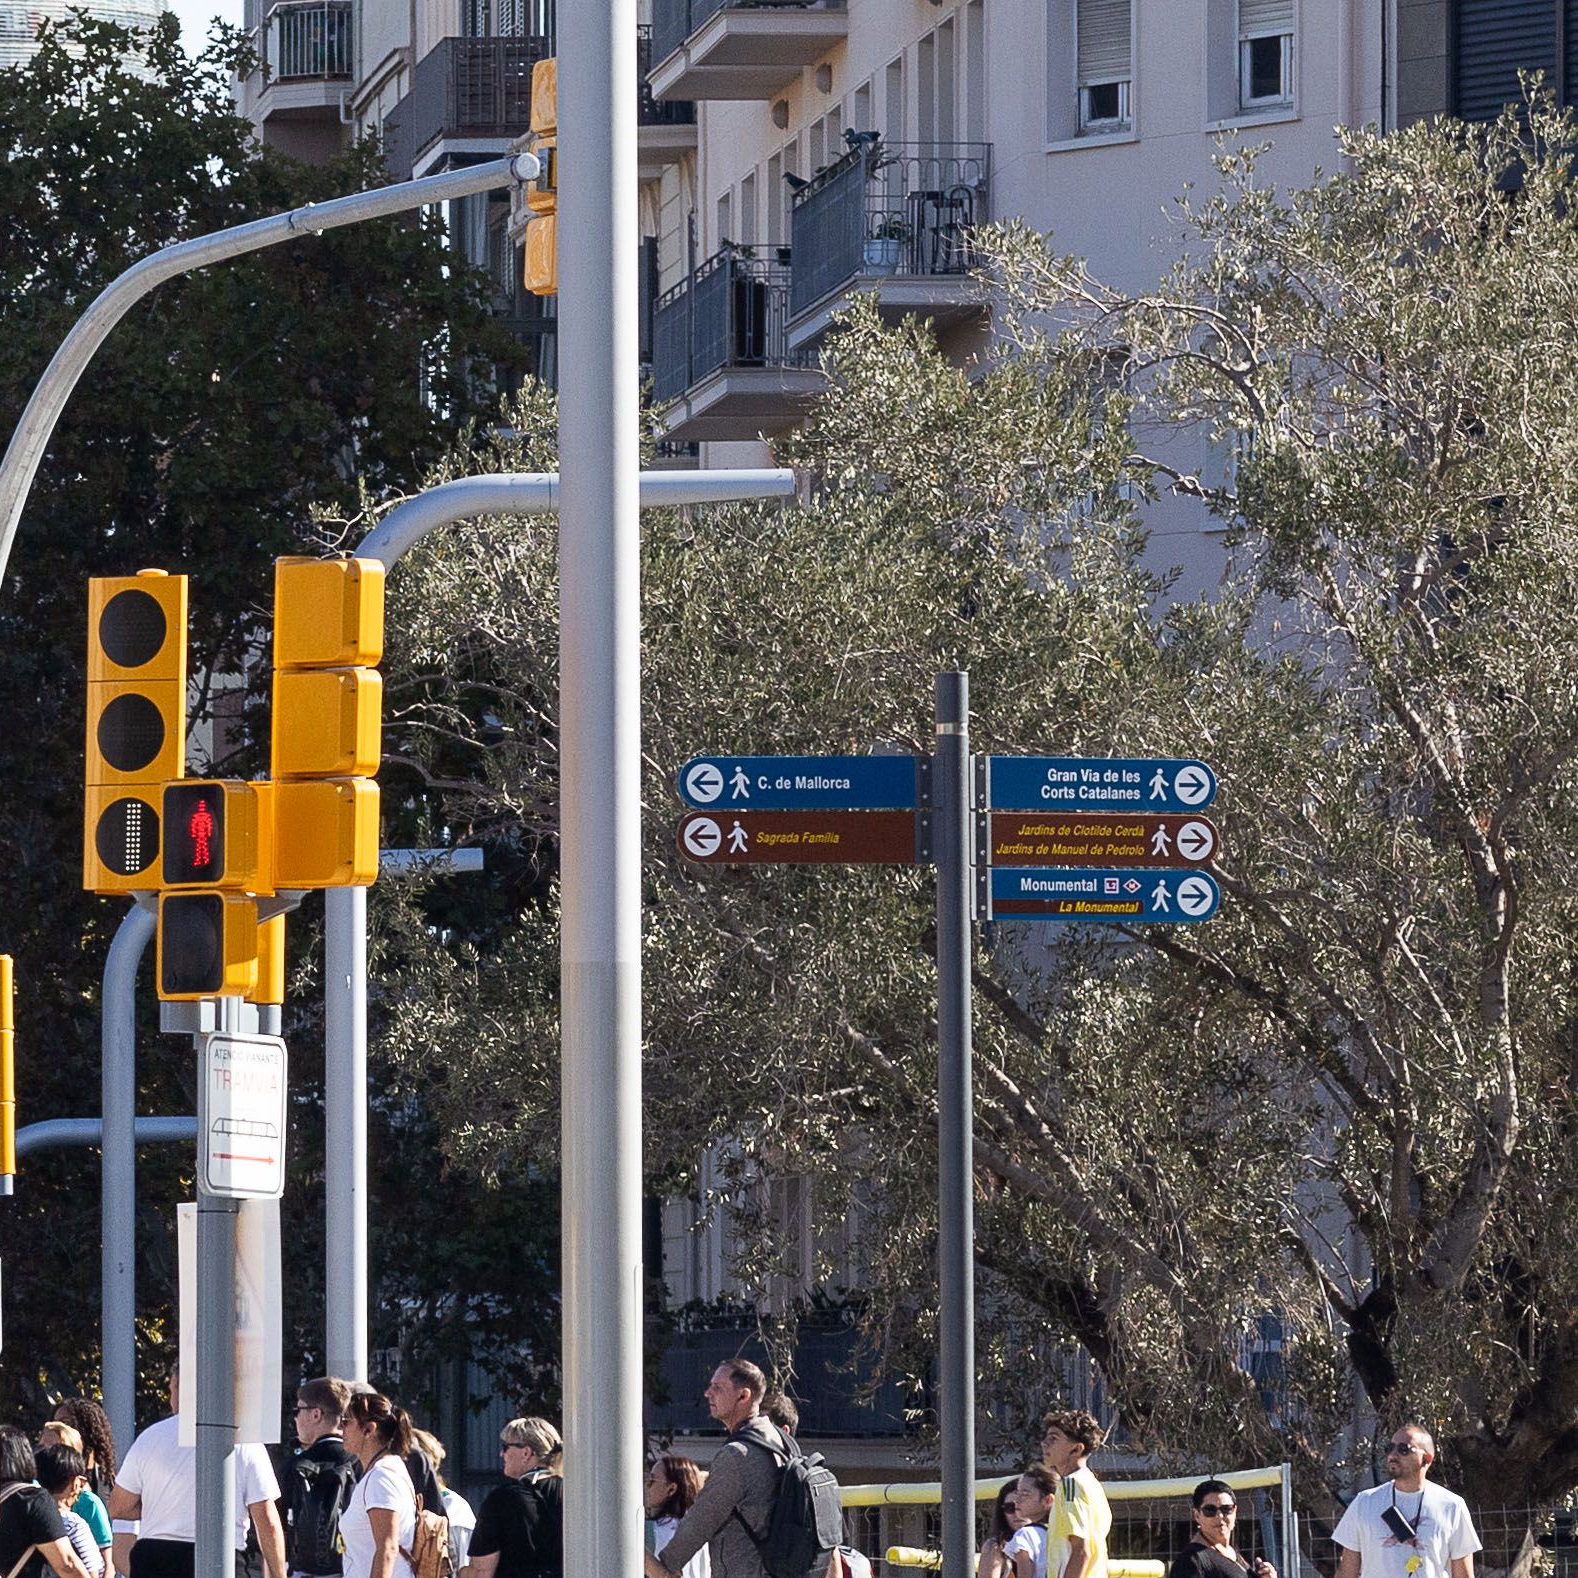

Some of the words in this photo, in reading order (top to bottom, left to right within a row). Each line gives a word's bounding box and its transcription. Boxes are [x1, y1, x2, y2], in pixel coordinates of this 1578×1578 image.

[757, 775, 772, 790] C.
[775, 775, 792, 790] de
[795, 775, 851, 790] Mallorca
[1047, 768, 1078, 782] Gran
[1080, 768, 1100, 782] Via
[1103, 769, 1119, 783] de
[1122, 769, 1141, 783] les
[1040, 784, 1076, 799] Corts
[1078, 785, 1141, 800] Catalanes
[1018, 824, 1055, 837] Jardins
[1057, 824, 1071, 837] de
[1073, 824, 1112, 837] Clotilde
[756, 831, 800, 846] Sagrada
[996, 843, 1034, 855] Jardins
[1035, 843, 1049, 855] de
[1051, 843, 1088, 856] Manuel
[1090, 844, 1103, 856] de
[1105, 844, 1145, 856] Pedrolo
[1020, 877, 1097, 892] Monumental
[1059, 901, 1072, 913] La
[1074, 901, 1139, 913] Monumental
[213, 1068, 278, 1095] TRAMVIA
